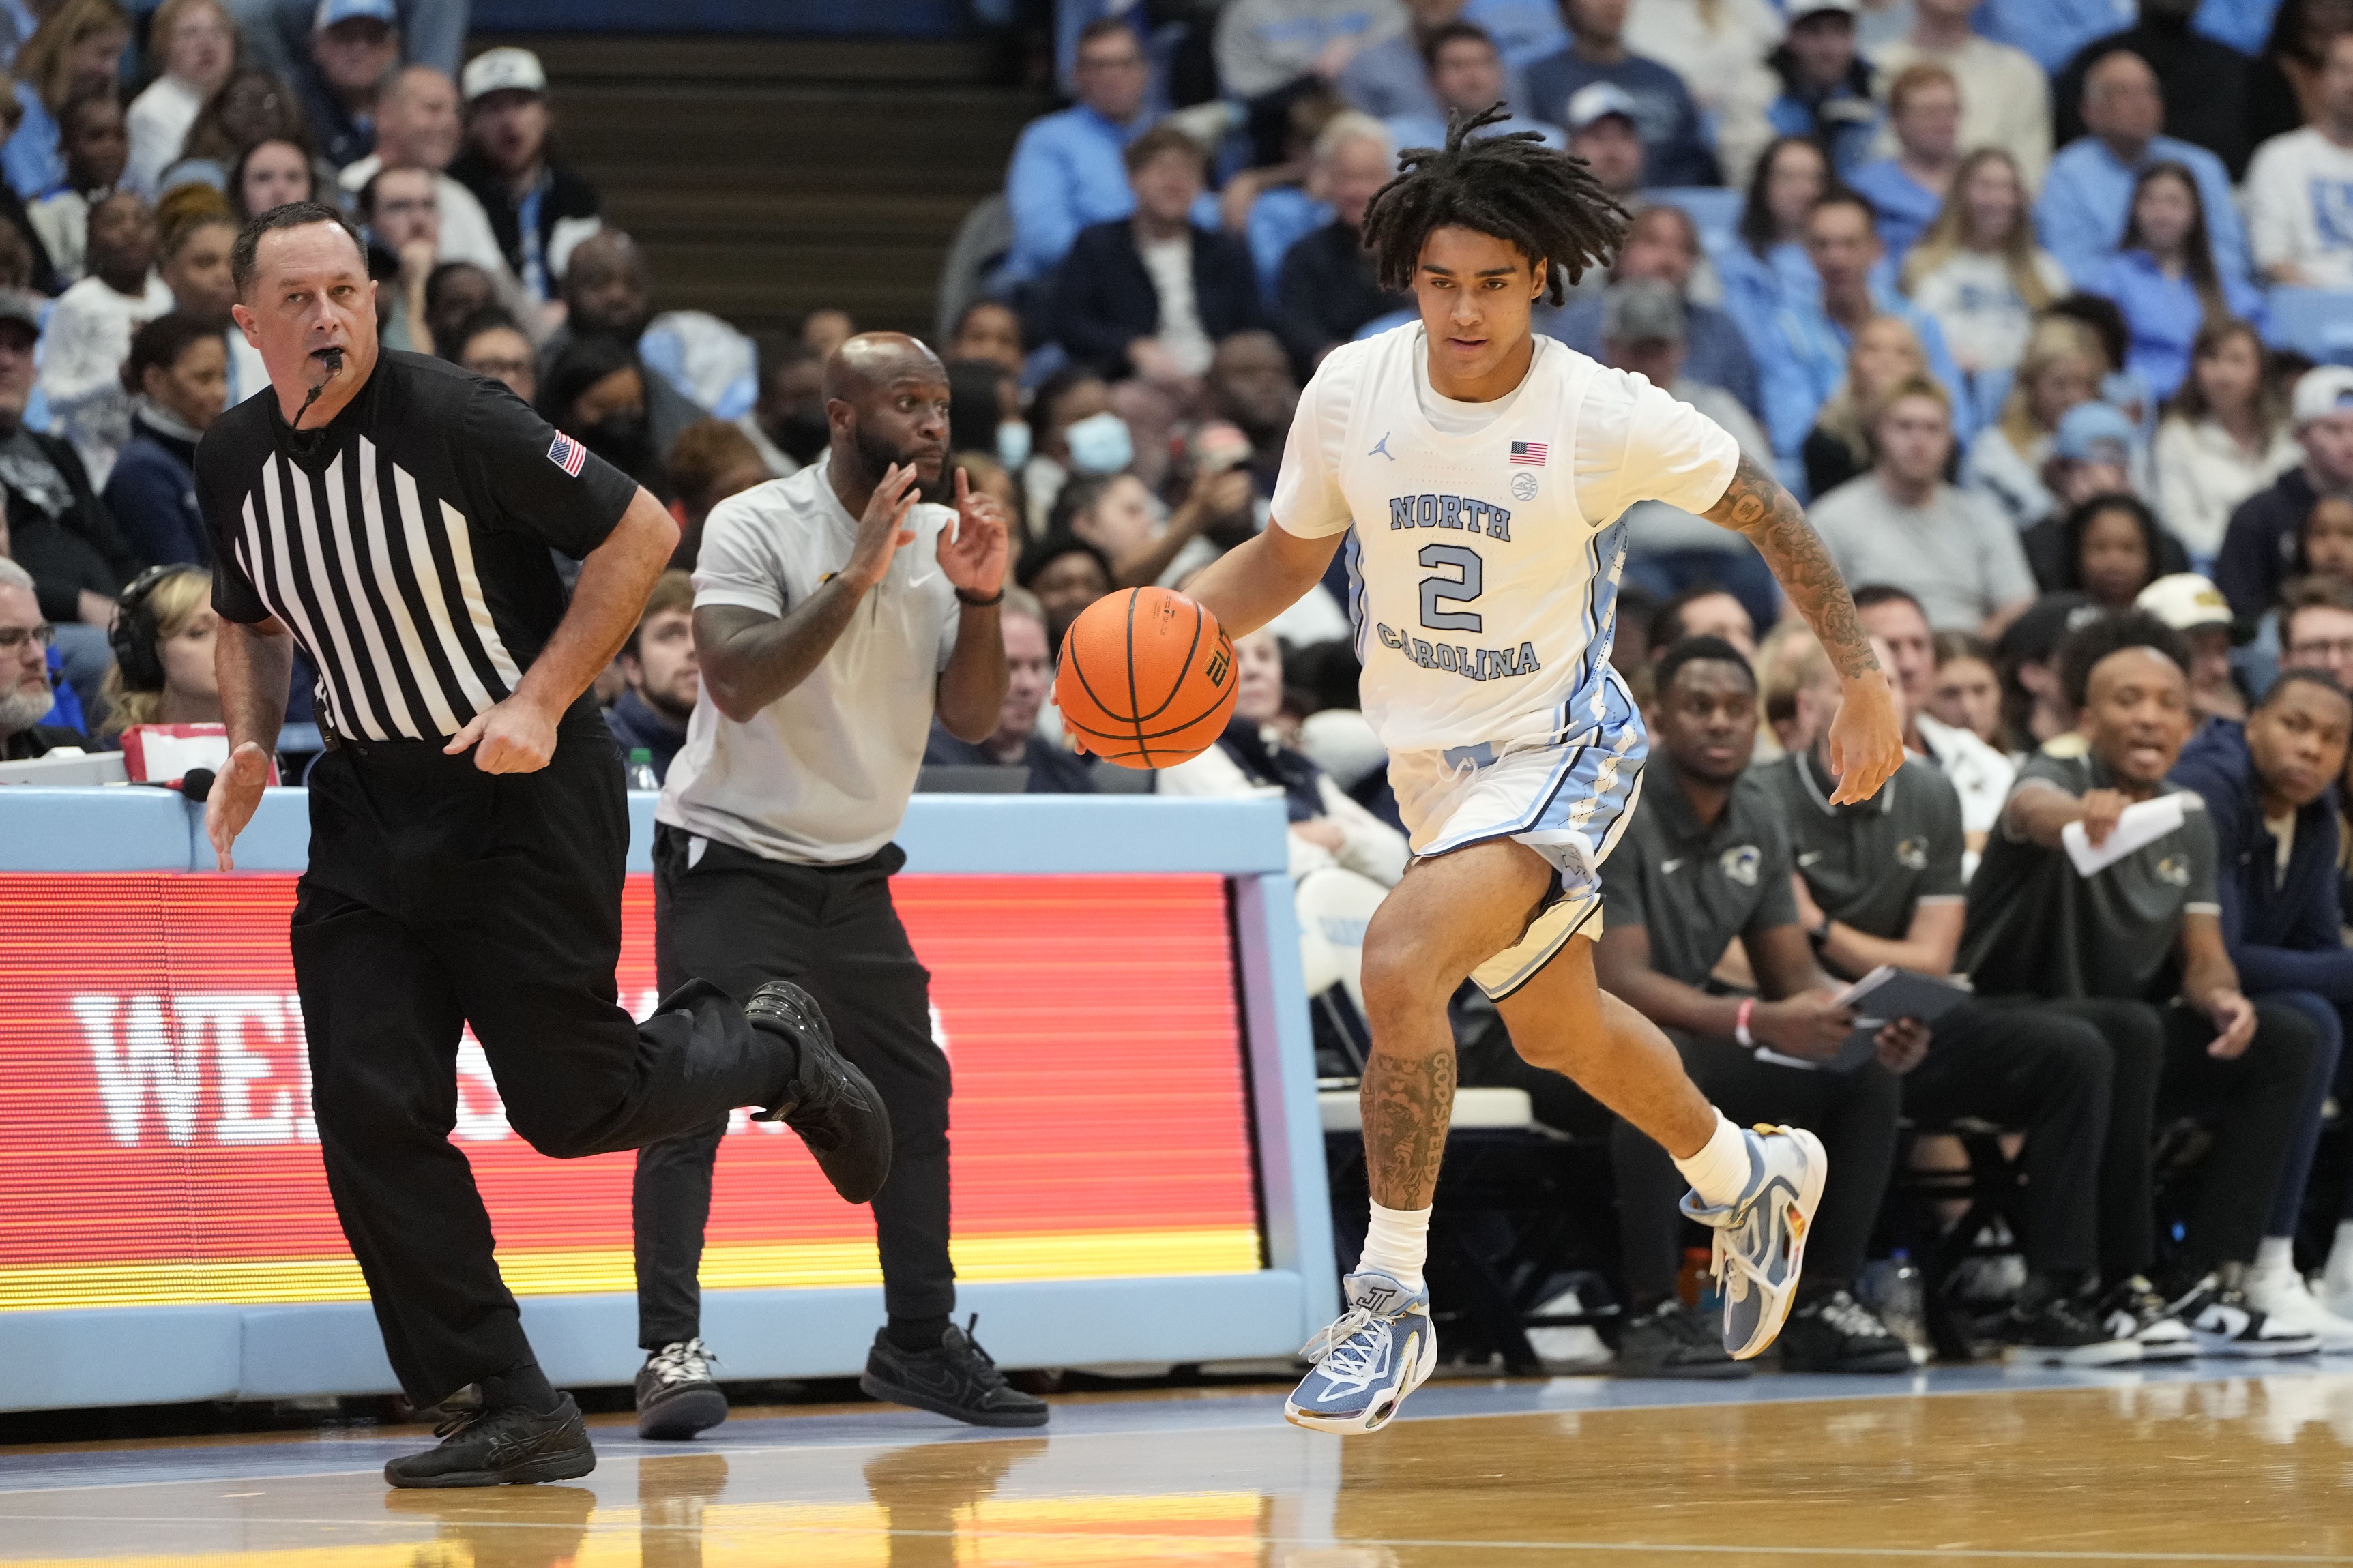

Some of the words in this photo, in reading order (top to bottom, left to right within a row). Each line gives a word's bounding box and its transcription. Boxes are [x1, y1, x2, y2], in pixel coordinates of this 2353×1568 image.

[1390, 494, 1511, 542] NORTH
[1419, 544, 1482, 633] 2
[1377, 622, 1540, 681] CAROLINA
[1423, 1052, 1451, 1181] GODSPEED
[1356, 1286, 1397, 1312] JT
